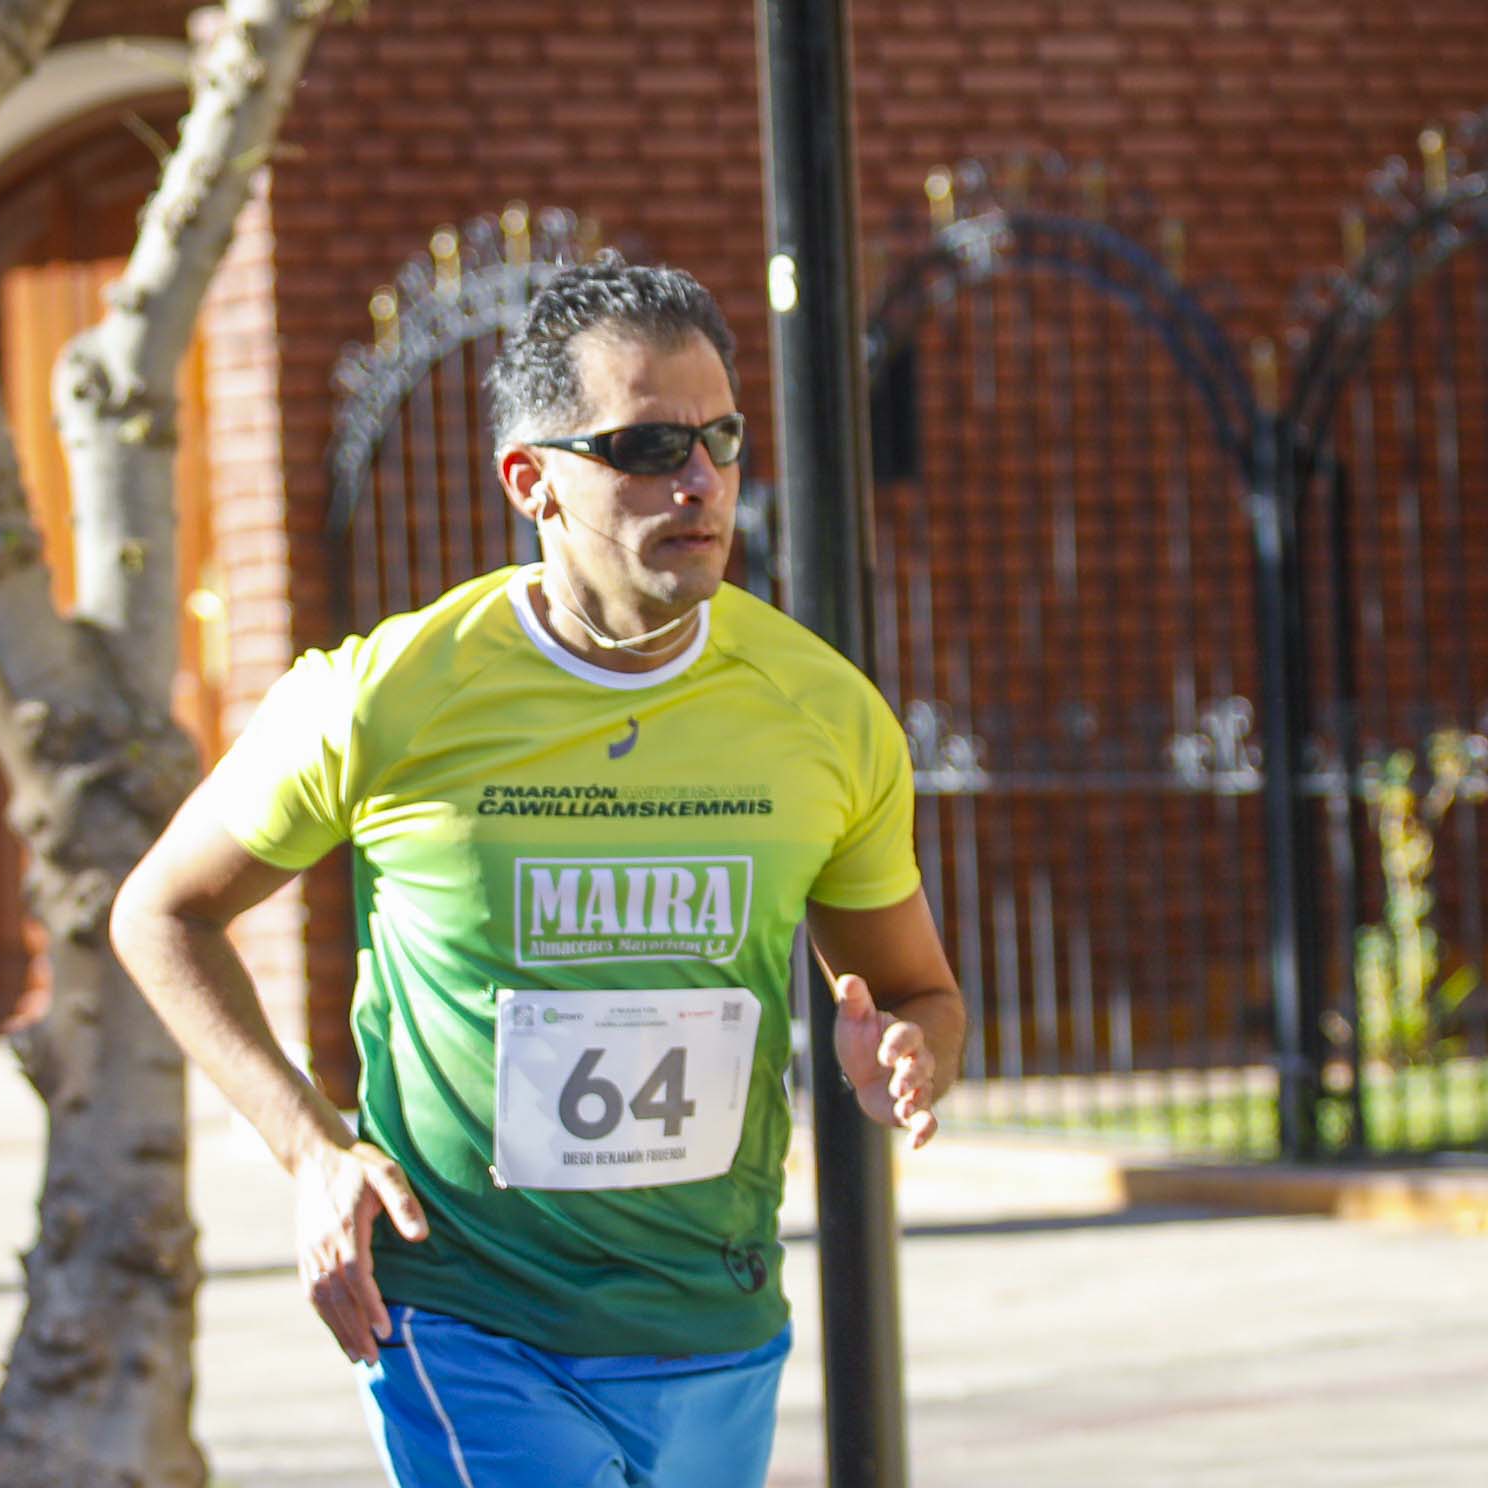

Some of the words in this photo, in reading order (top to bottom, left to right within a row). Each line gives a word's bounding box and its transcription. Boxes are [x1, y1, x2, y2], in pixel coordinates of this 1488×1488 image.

[529, 866, 734, 936] MAIRA
[558, 1046, 696, 1140] 64
[562, 1151, 593, 1165] DIEGO
